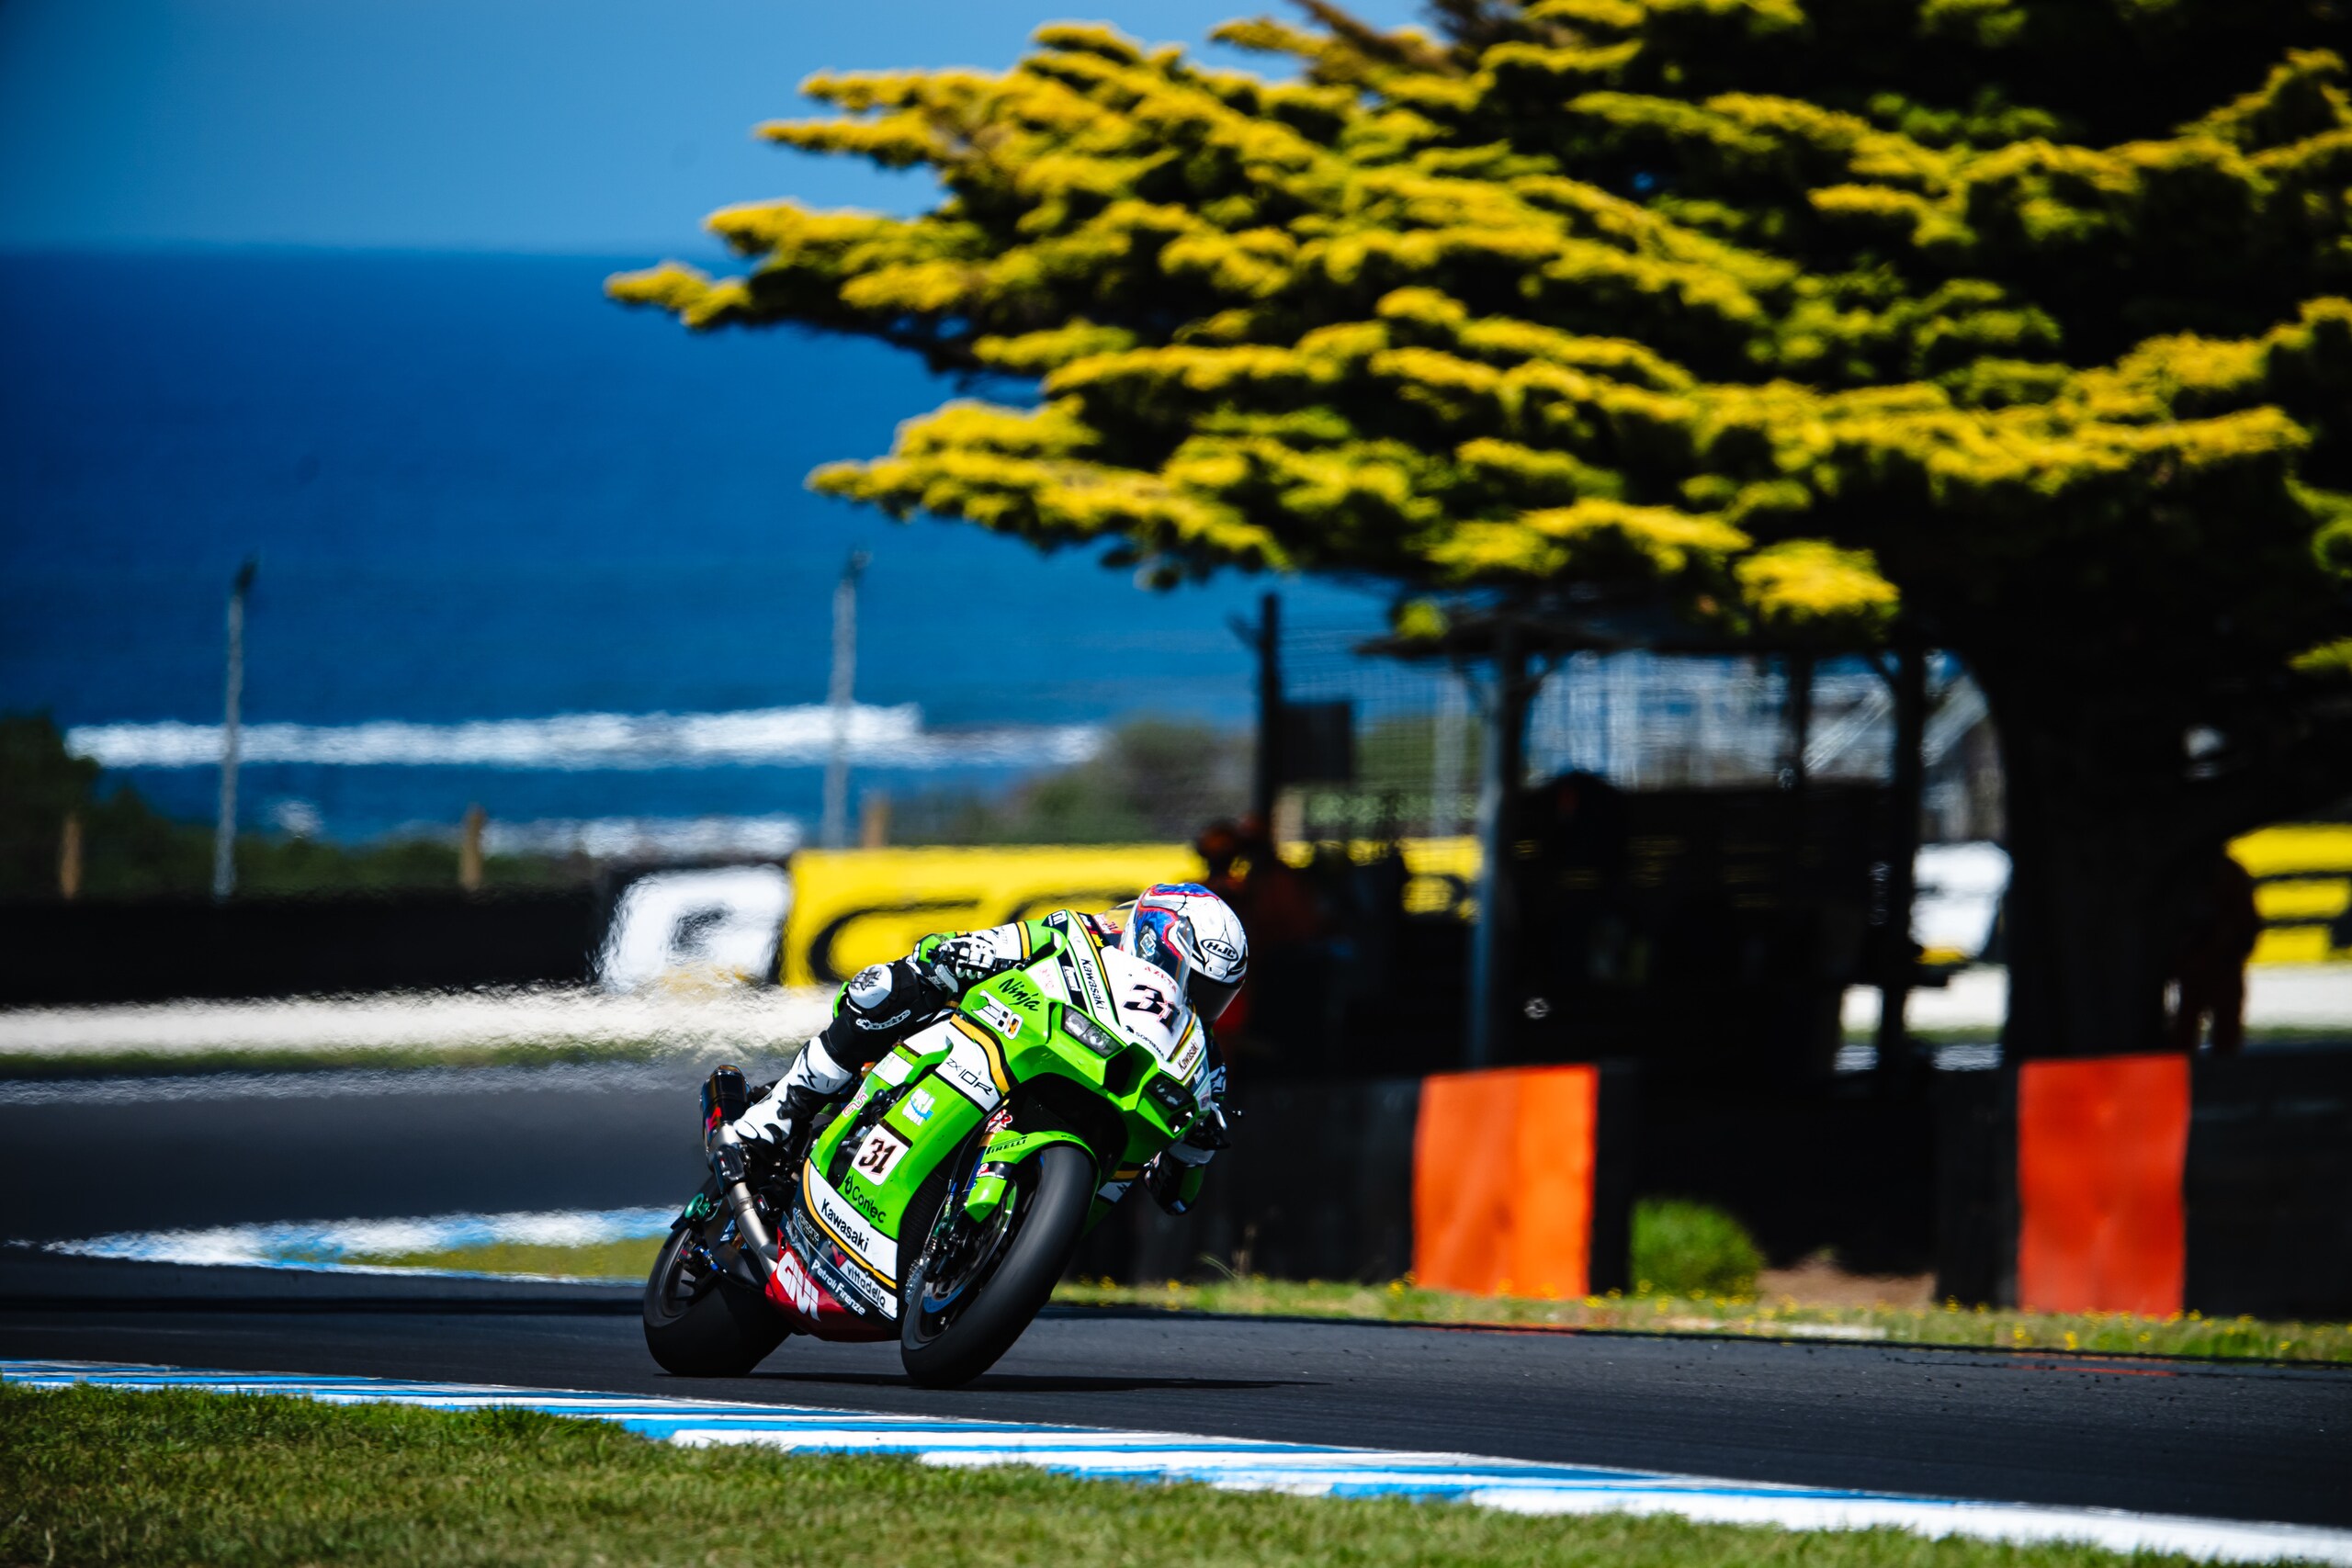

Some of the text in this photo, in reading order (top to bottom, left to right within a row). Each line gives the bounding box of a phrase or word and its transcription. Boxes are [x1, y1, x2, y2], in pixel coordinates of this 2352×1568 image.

[1206, 942, 1236, 959] HJC
[998, 977, 1041, 1011] Ninja
[1080, 958, 1108, 1010] Kawasaki
[1122, 983, 1175, 1036] 31
[945, 1057, 993, 1097] ZX-10R
[858, 1137, 898, 1176] 31
[985, 1135, 1028, 1155] PIRELLI
[820, 1198, 870, 1253] Kawasaki
[810, 1258, 865, 1315] Petroli Firenze
